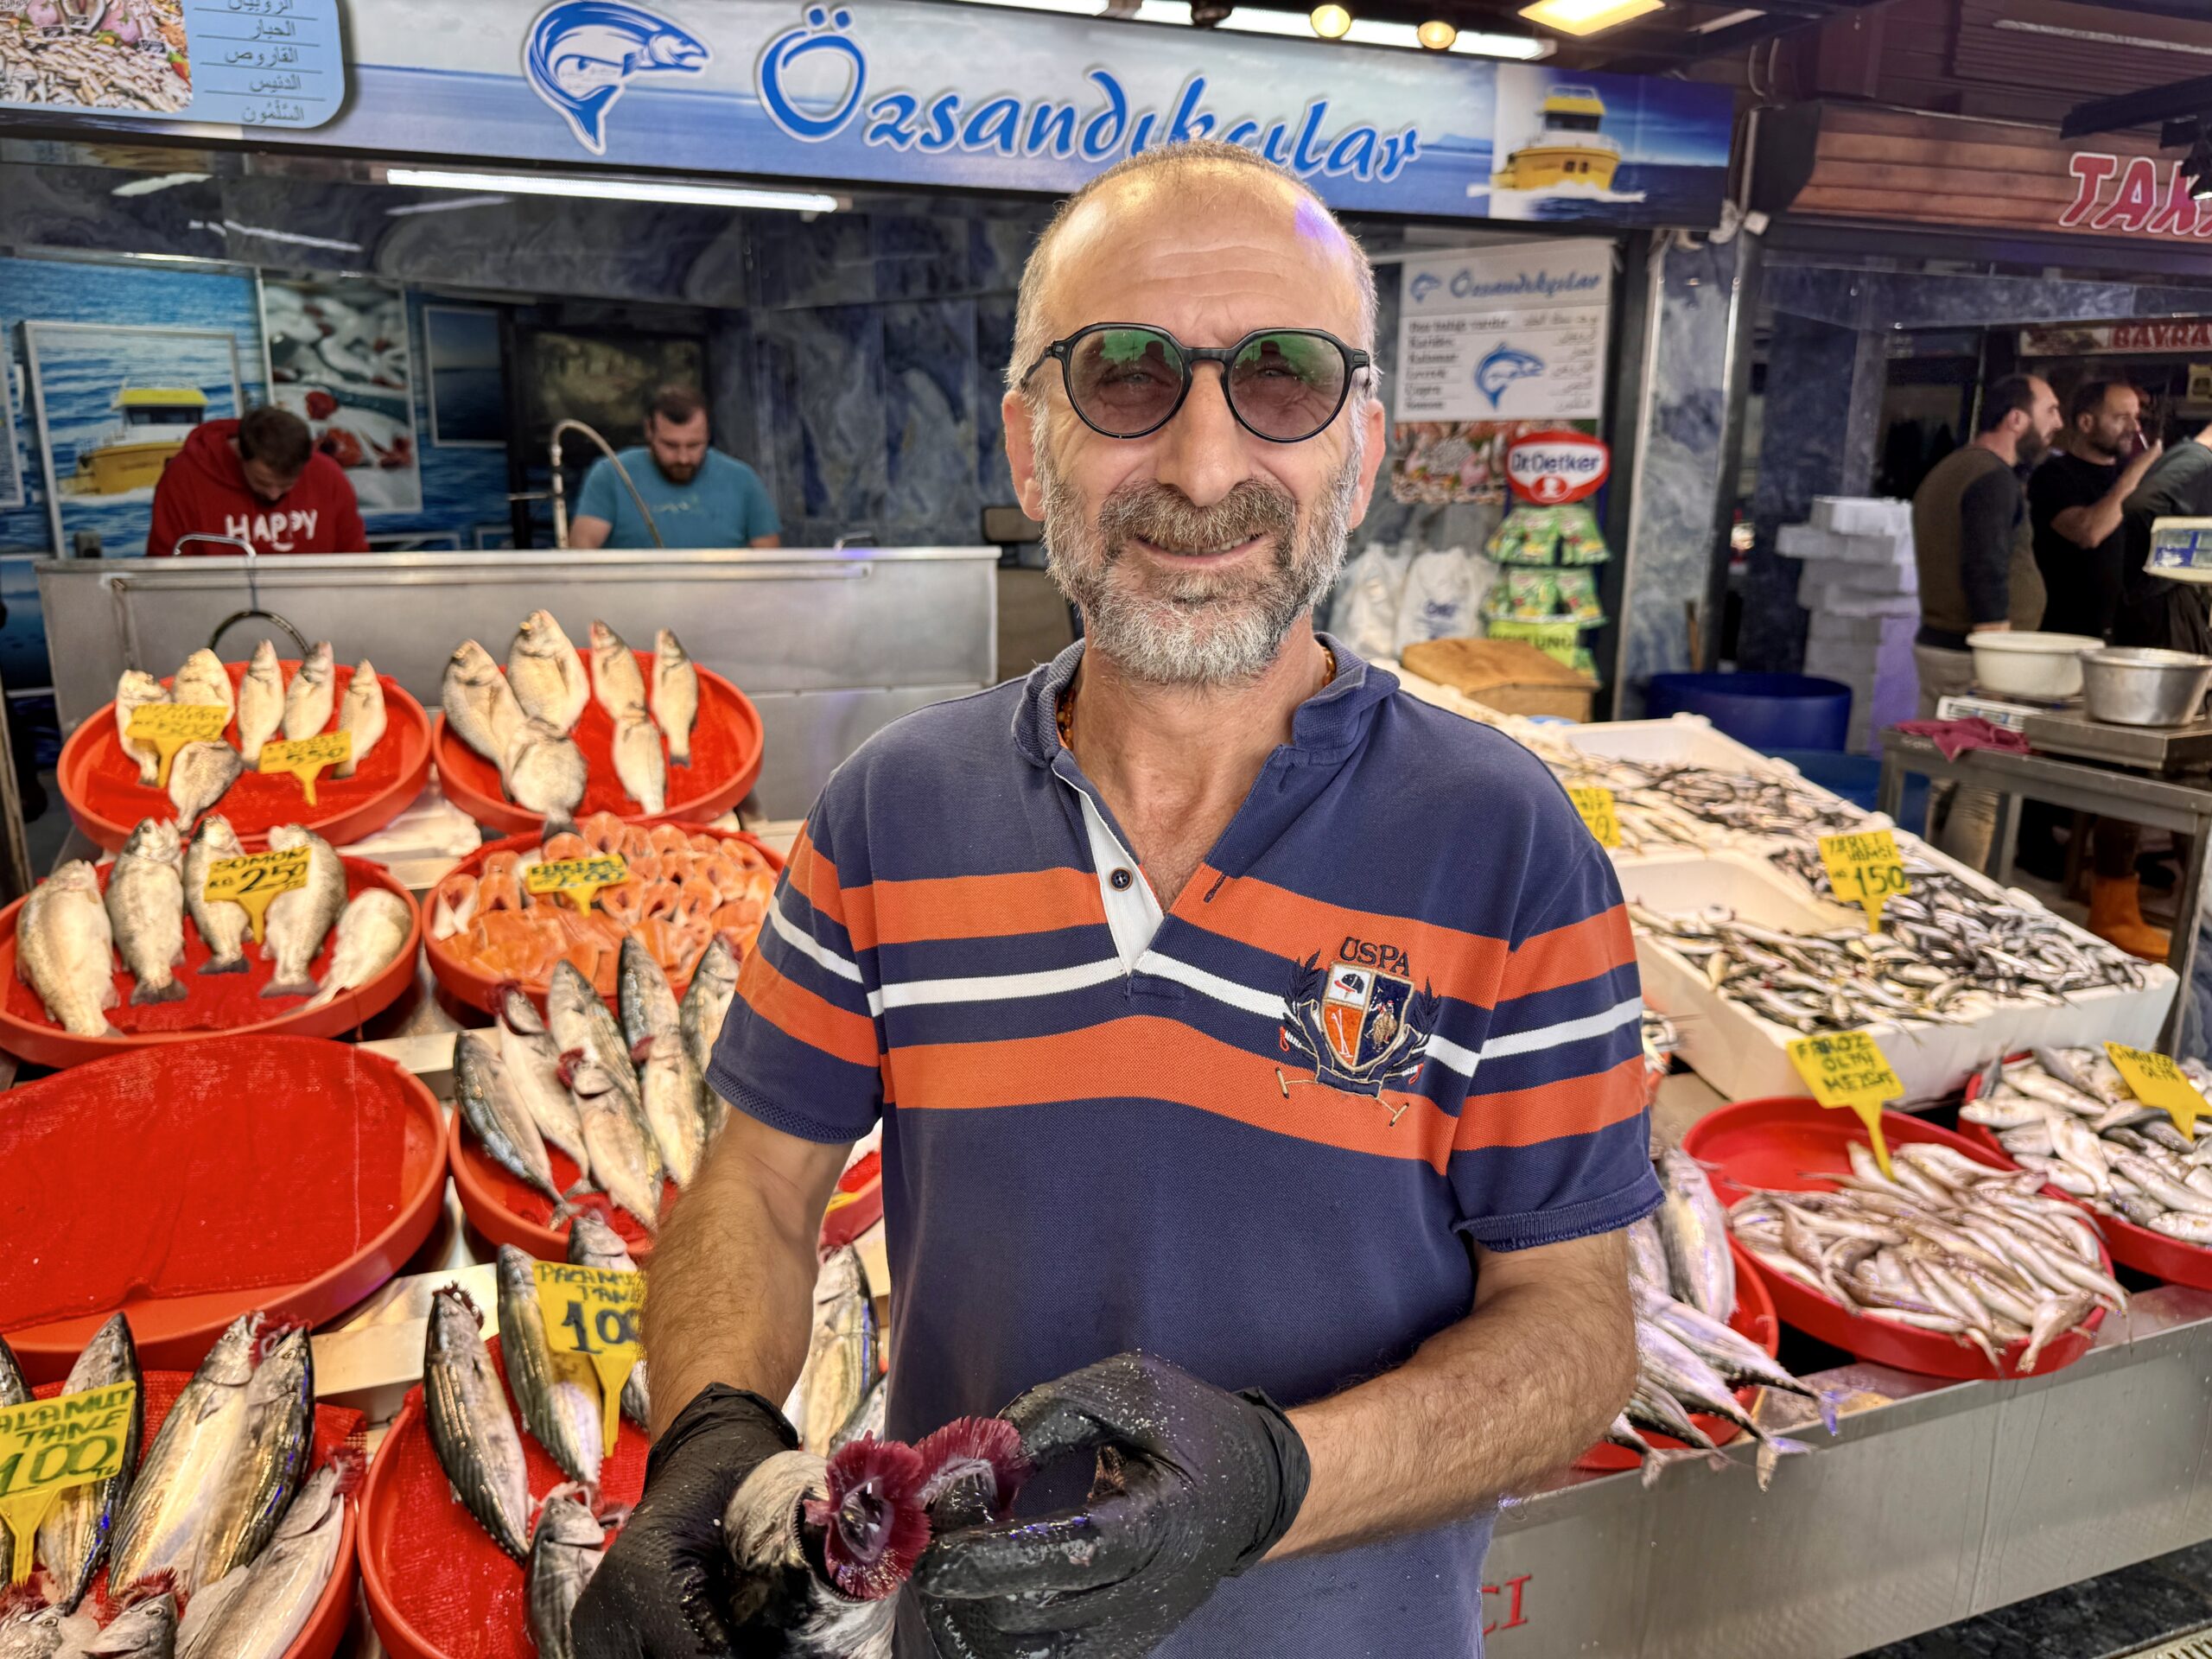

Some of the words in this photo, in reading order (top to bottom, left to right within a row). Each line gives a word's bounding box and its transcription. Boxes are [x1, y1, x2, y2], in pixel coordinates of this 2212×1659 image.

[2109, 323, 2212, 348] BAYRA
[226, 509, 318, 542] HAPPY
[213, 845, 312, 873] SOMON
[1854, 865, 1906, 898] 150
[1339, 936, 1410, 977] USPA
[0, 1386, 134, 1434] ALAMUT
[16, 1408, 128, 1448] TANE
[0, 1435, 118, 1497] 100
